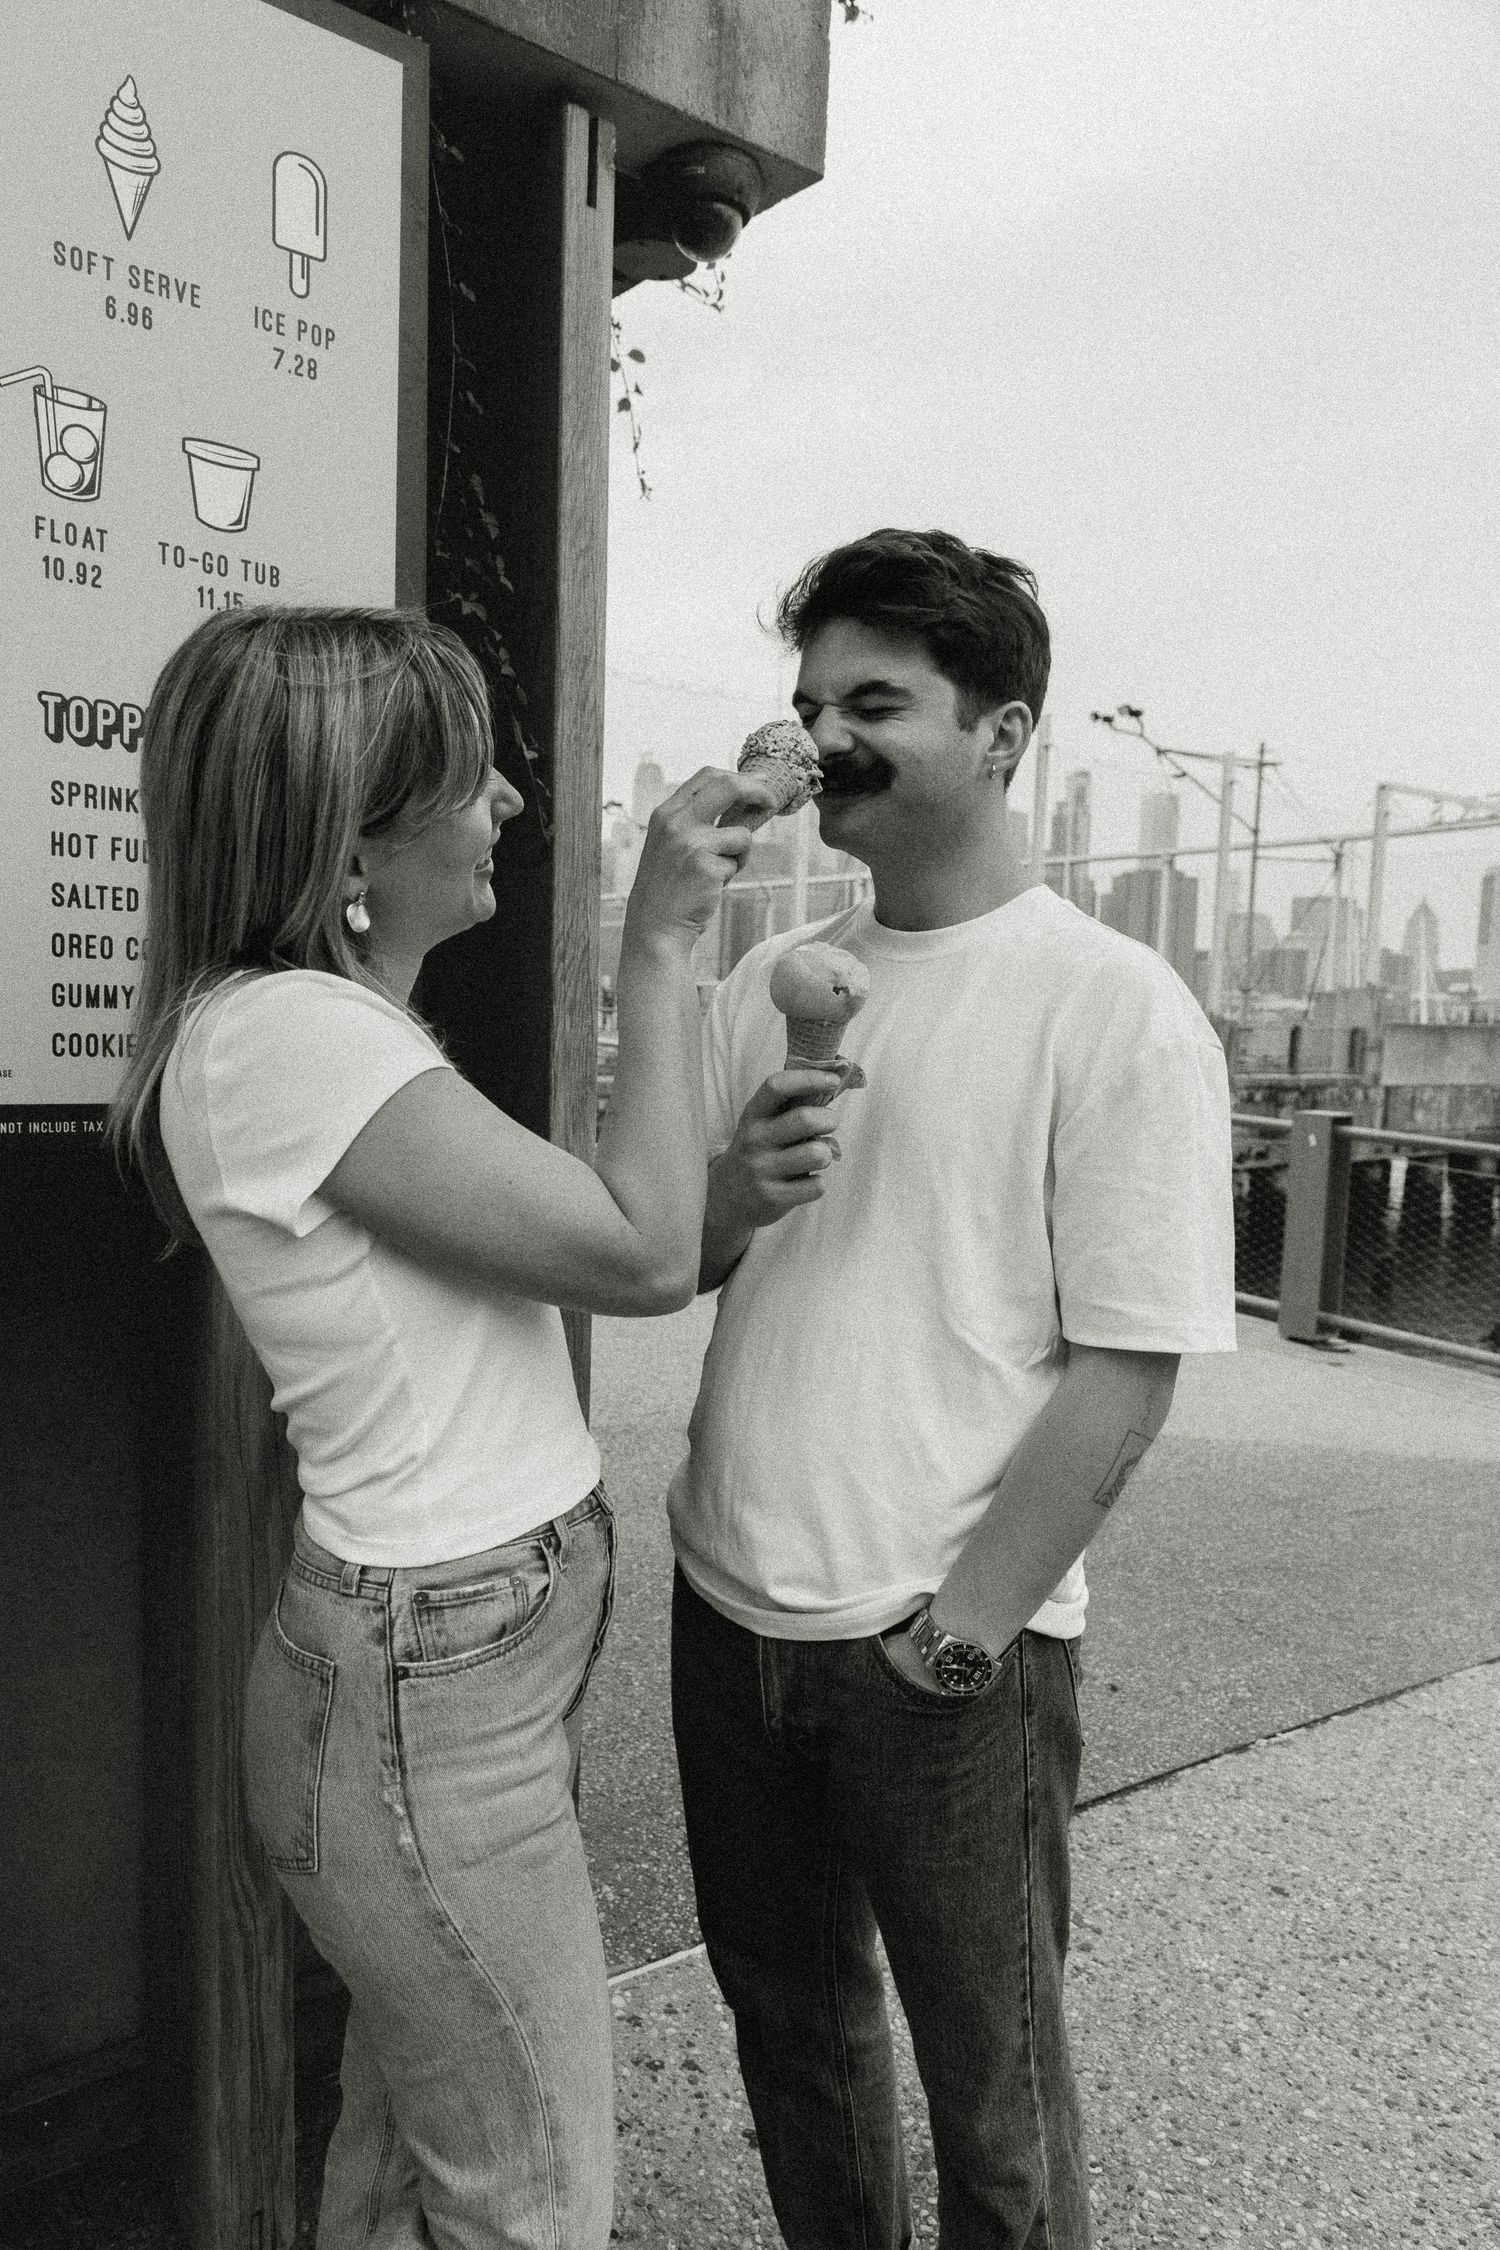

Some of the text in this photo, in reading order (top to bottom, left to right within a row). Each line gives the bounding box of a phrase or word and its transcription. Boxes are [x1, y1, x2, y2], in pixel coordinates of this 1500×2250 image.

[53, 241, 201, 309] SOFT SERVE
[105, 295, 154, 331] 6.96
[254, 306, 336, 350] ICE POP
[272, 347, 319, 381] 7.28
[34, 515, 108, 554] FLOAT
[42, 555, 102, 589] 10.92
[158, 541, 280, 588] TO-GO TUB
[37, 690, 149, 753] TOPP
[50, 780, 139, 814] SPRINK
[51, 830, 98, 860] HOT
[51, 882, 140, 912] SALTED
[51, 932, 114, 961] OREO
[51, 982, 135, 1010] GUMMY
[0, 1120, 104, 1134] NOT INCLUDE TAX
